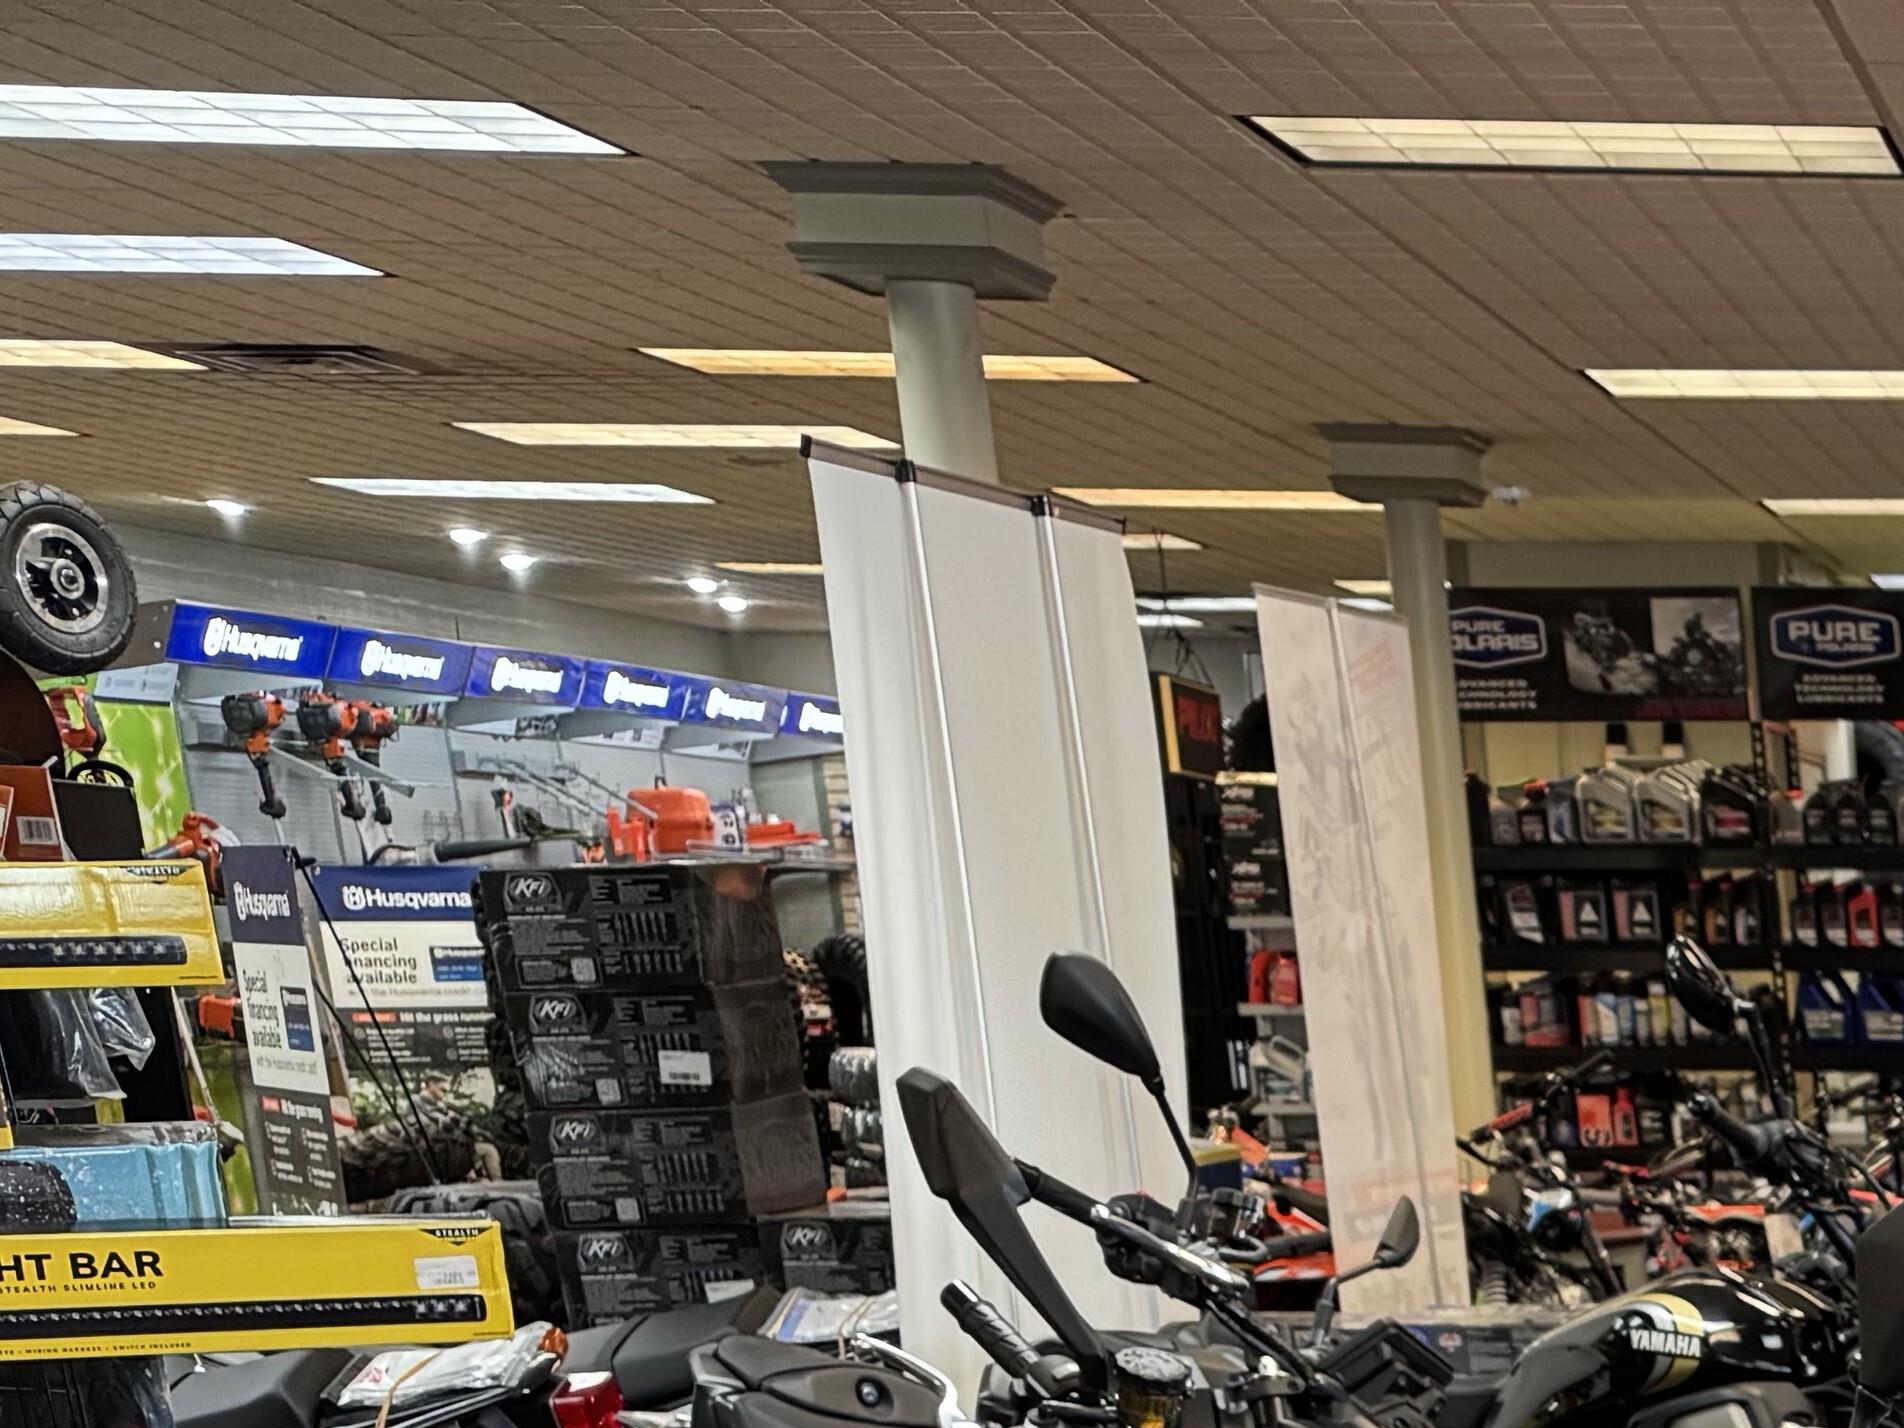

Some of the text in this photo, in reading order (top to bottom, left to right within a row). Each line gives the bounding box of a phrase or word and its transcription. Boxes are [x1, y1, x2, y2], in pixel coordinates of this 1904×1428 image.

[1787, 621, 1882, 642] PURE
[244, 885, 292, 921] Husqvarna
[365, 887, 473, 911] Husqvarna
[340, 937, 399, 954] Special
[69, 1250, 164, 1280] BAR
[1629, 1328, 1701, 1358] YAMAHA
